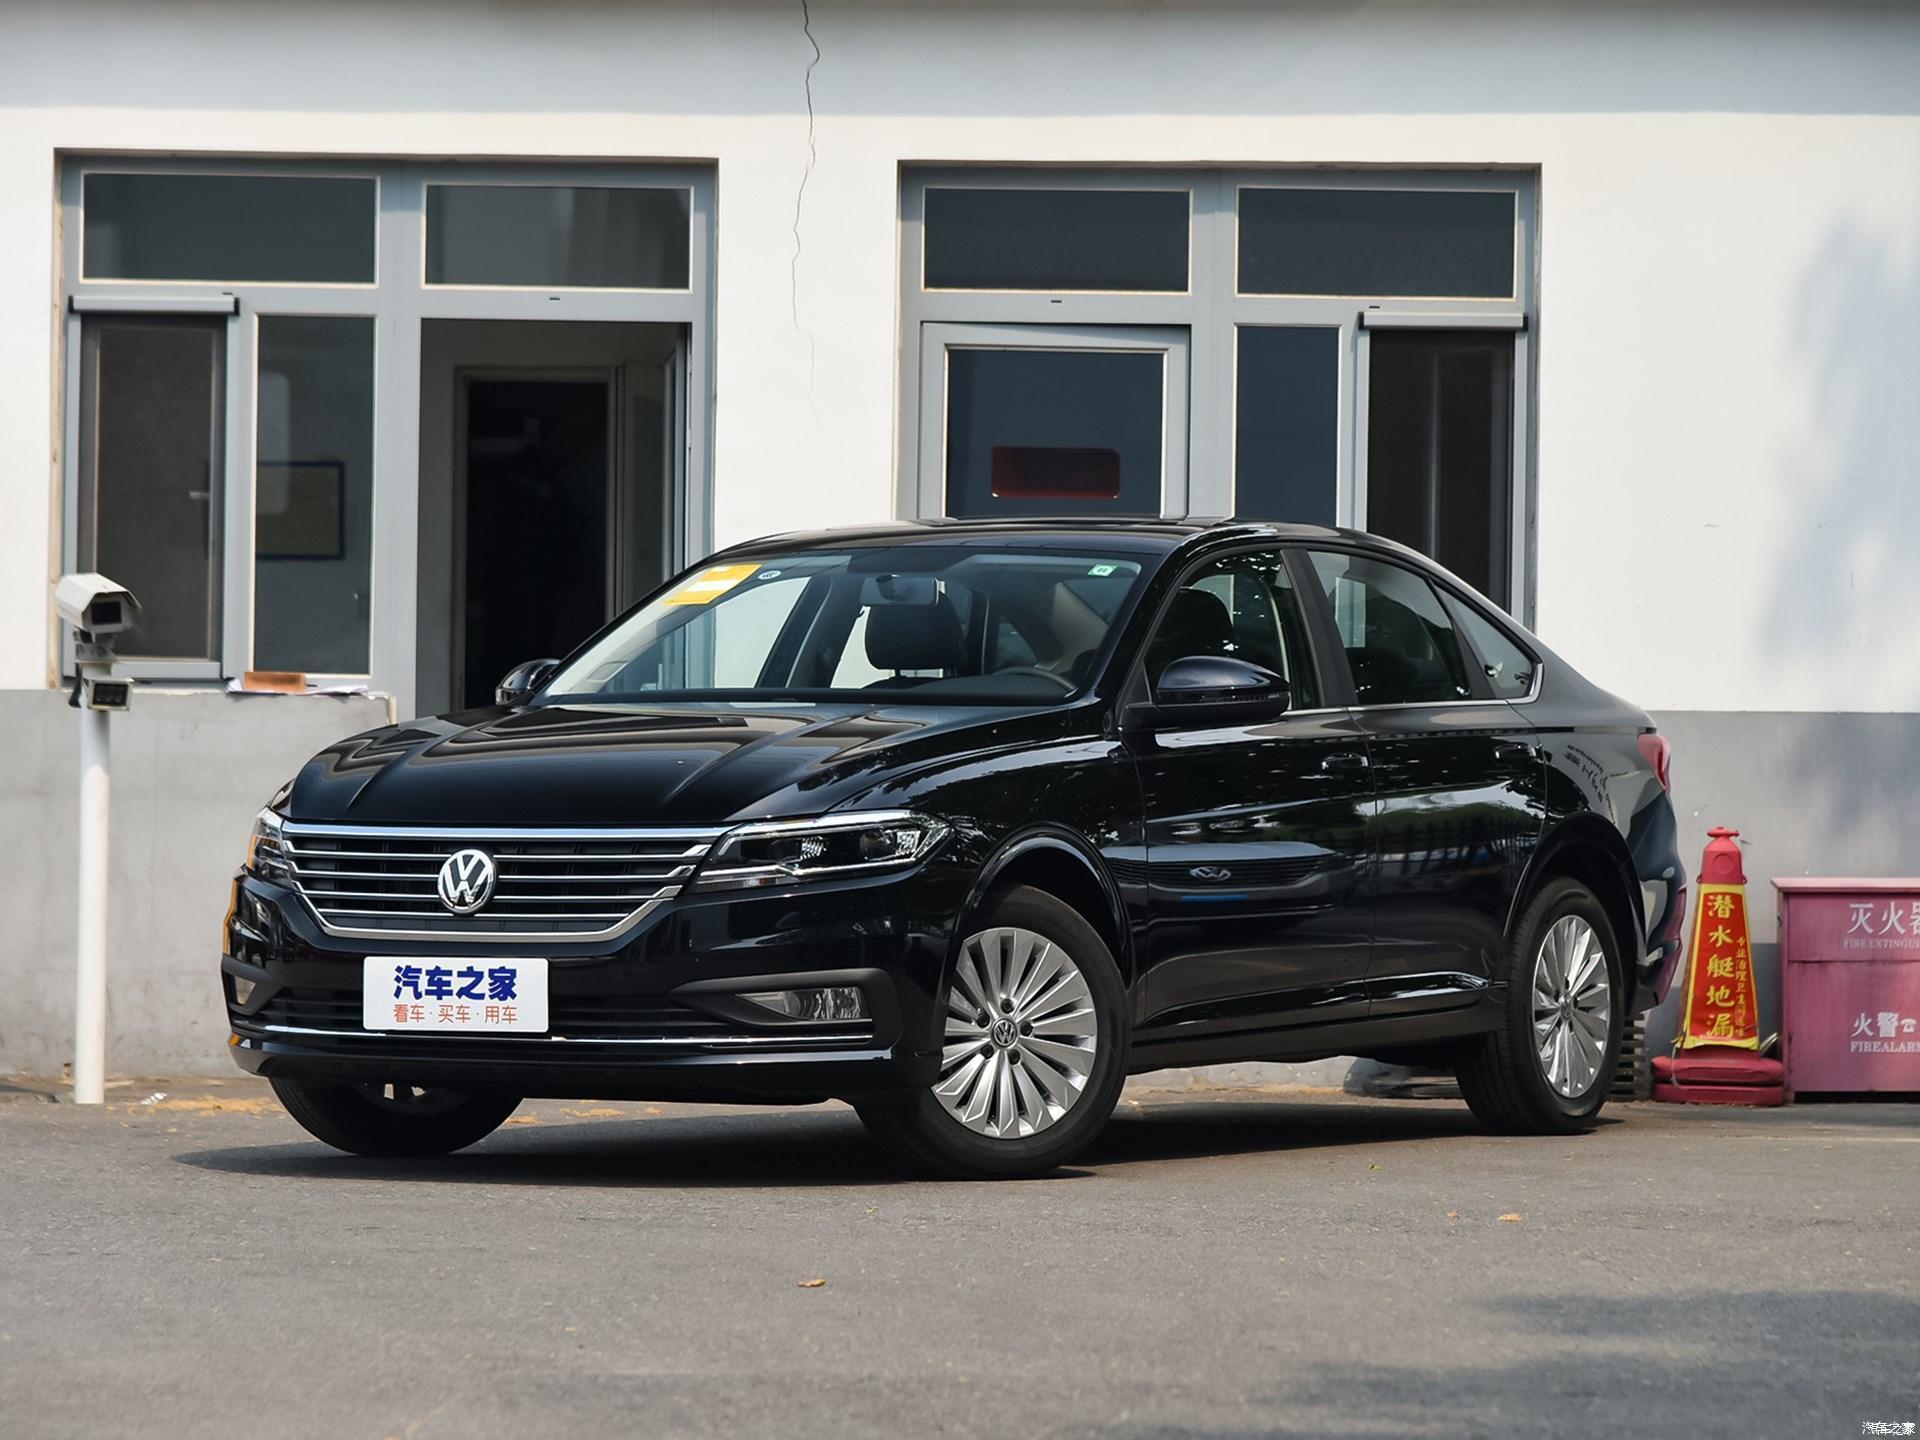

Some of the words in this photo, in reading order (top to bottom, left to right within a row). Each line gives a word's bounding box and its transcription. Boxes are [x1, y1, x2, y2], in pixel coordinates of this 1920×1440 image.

[393, 965, 517, 1001] 汽车之家
[1706, 894, 1735, 1039] 潜水艇地漏
